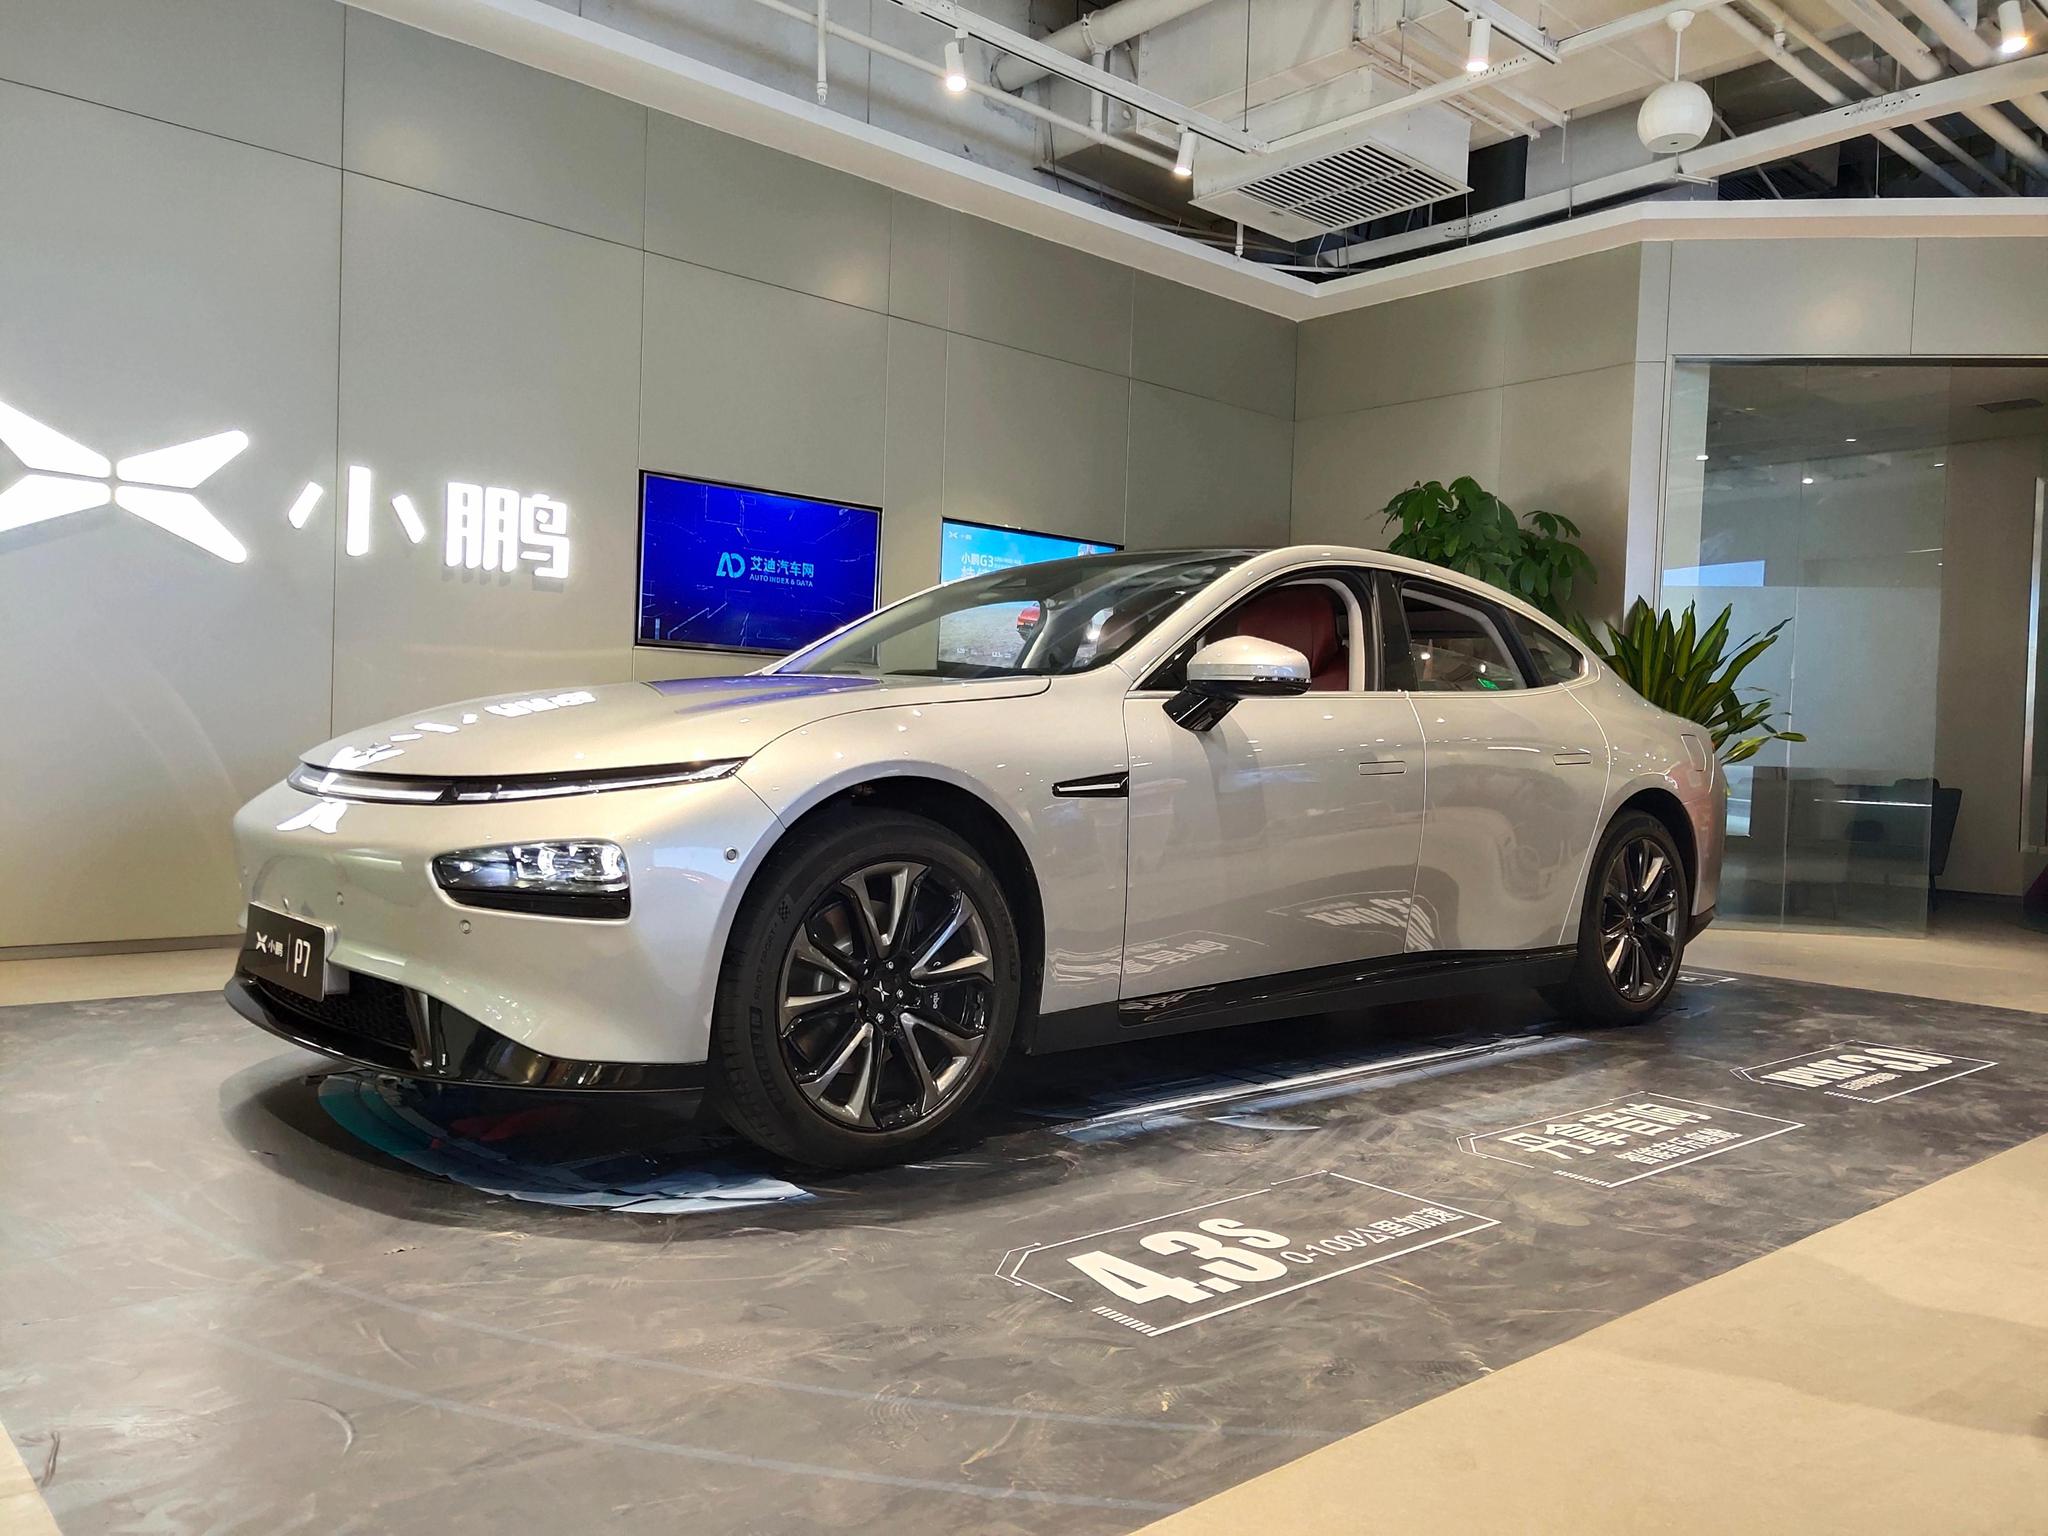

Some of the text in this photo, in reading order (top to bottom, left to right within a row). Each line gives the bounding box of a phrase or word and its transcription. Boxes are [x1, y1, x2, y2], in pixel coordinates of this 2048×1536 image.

[287, 465, 570, 579] 小鹏
[749, 574, 769, 582] AUTO
[769, 576, 790, 585] INDEX
[796, 579, 814, 587] DATA
[750, 556, 815, 578] 艾迪汽车网
[268, 939, 311, 977] 小鹏 P7
[1760, 1059, 1878, 1088] XPILOT
[1837, 1048, 1953, 1072] 3.0
[1497, 1103, 1712, 1160] 丹拿音响
[1614, 1127, 1743, 1165] 智能音乐座舱
[1280, 1206, 1464, 1265] 0-100公里加速
